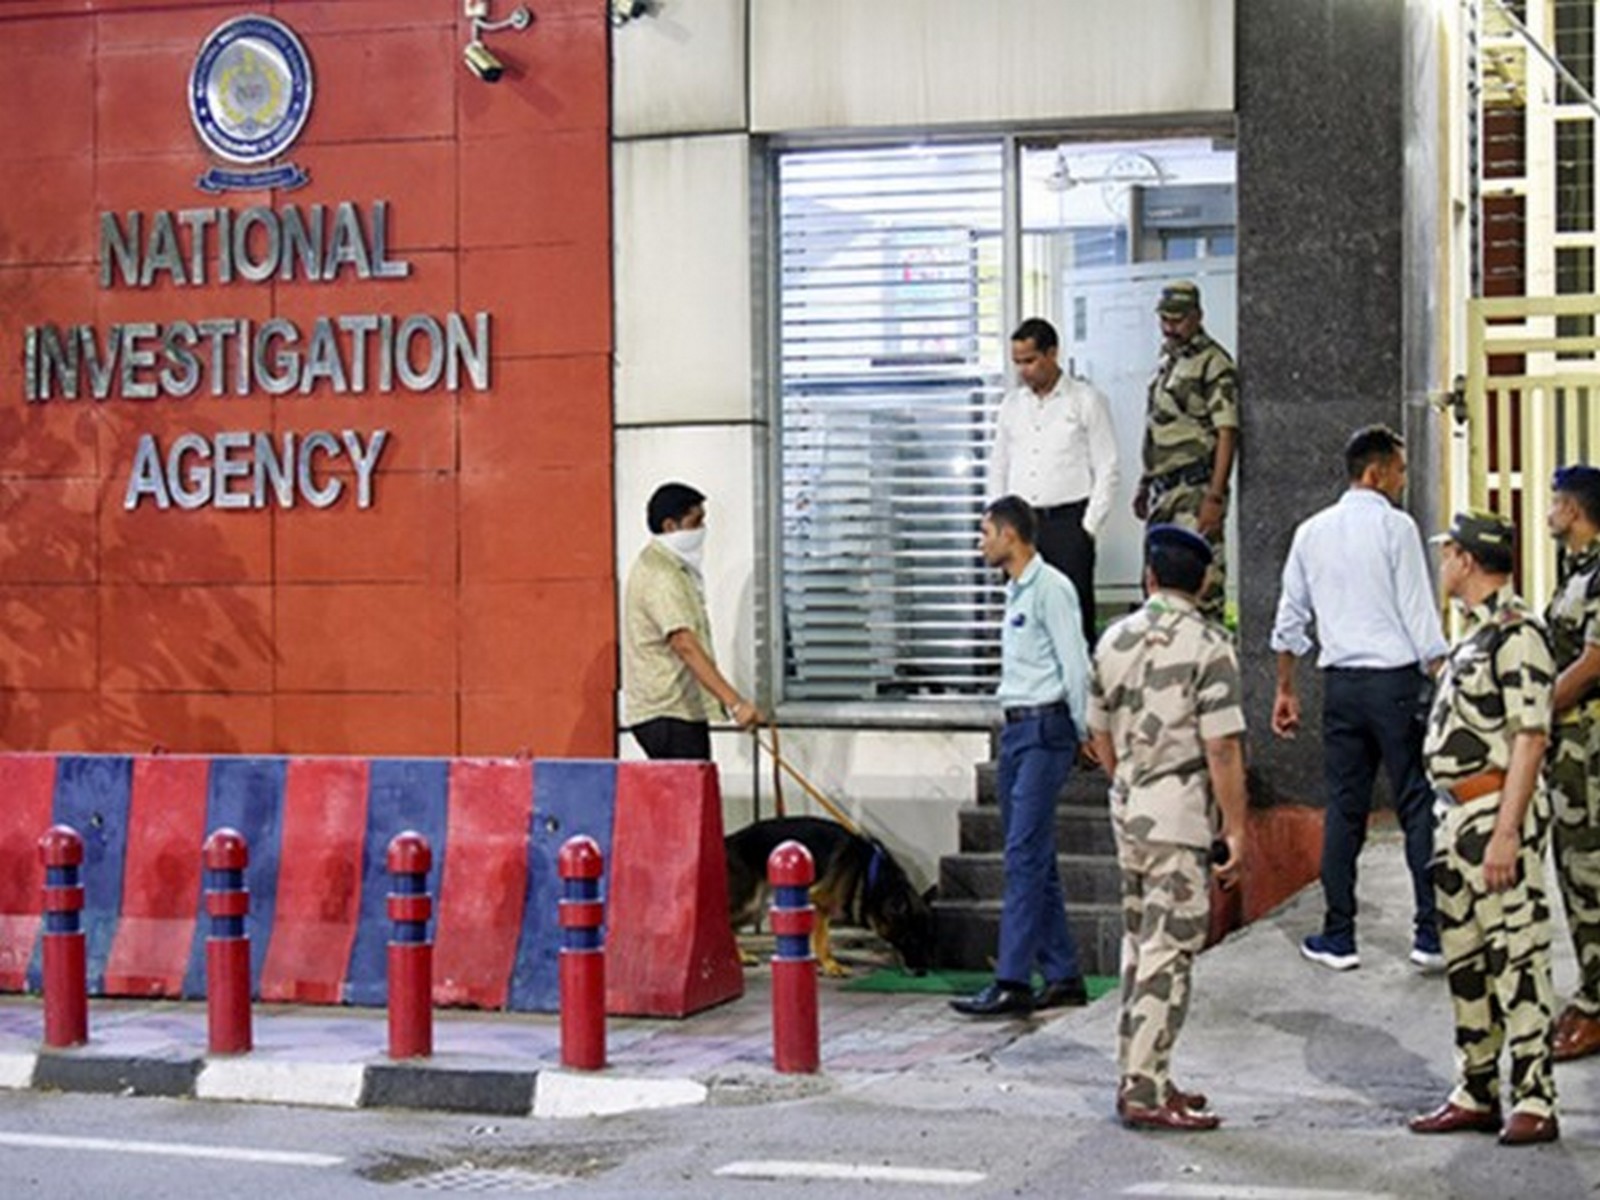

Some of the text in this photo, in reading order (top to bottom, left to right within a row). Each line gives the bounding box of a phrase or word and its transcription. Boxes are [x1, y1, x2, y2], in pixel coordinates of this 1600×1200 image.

[99, 200, 409, 286] NATIONAL
[24, 312, 491, 401] INVESTIGATION
[124, 430, 388, 510] AGENCY
